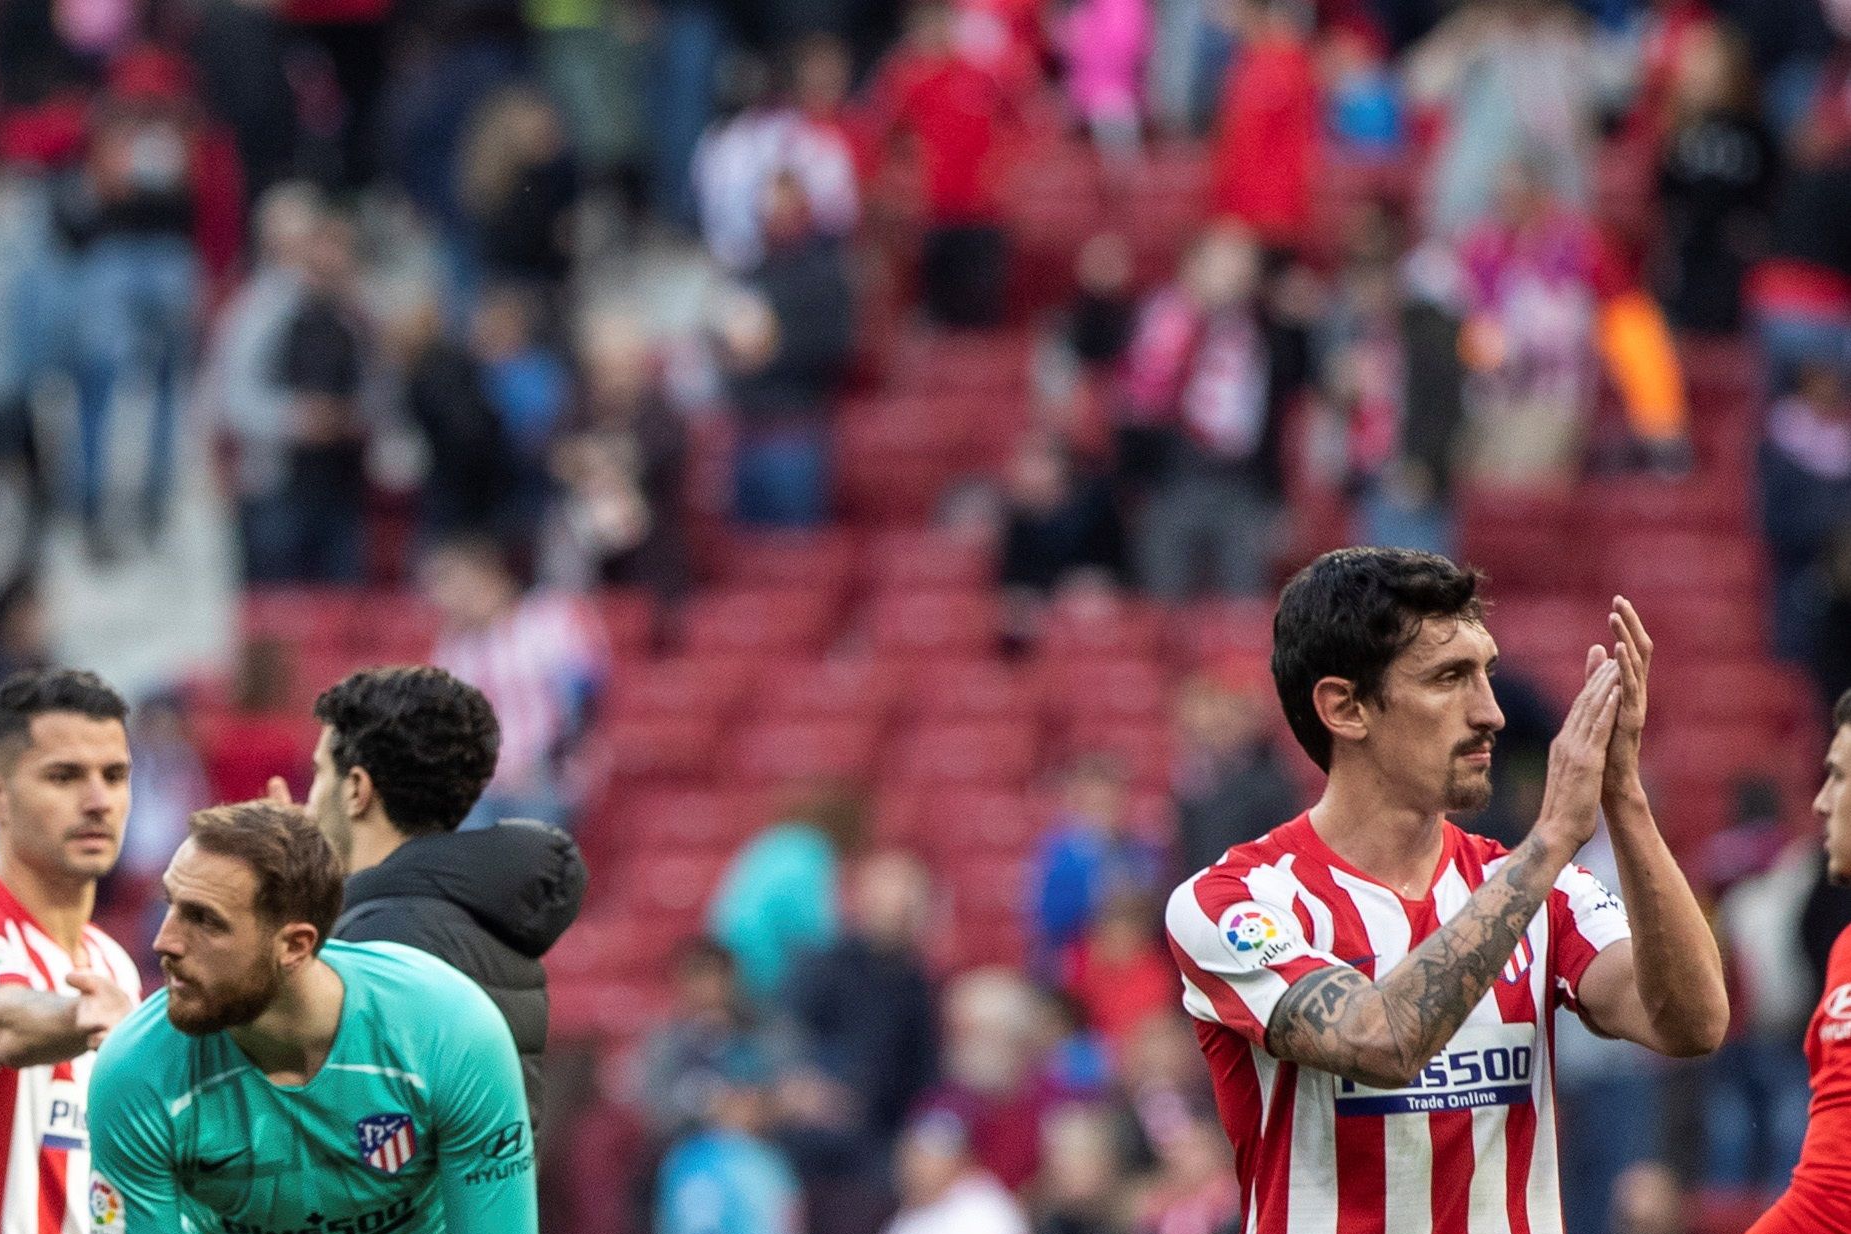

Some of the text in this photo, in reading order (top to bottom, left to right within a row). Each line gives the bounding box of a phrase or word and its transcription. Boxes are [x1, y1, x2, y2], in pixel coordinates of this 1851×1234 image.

[1342, 1046, 1532, 1093] s500
[1406, 1090, 1497, 1111] Trade Online
